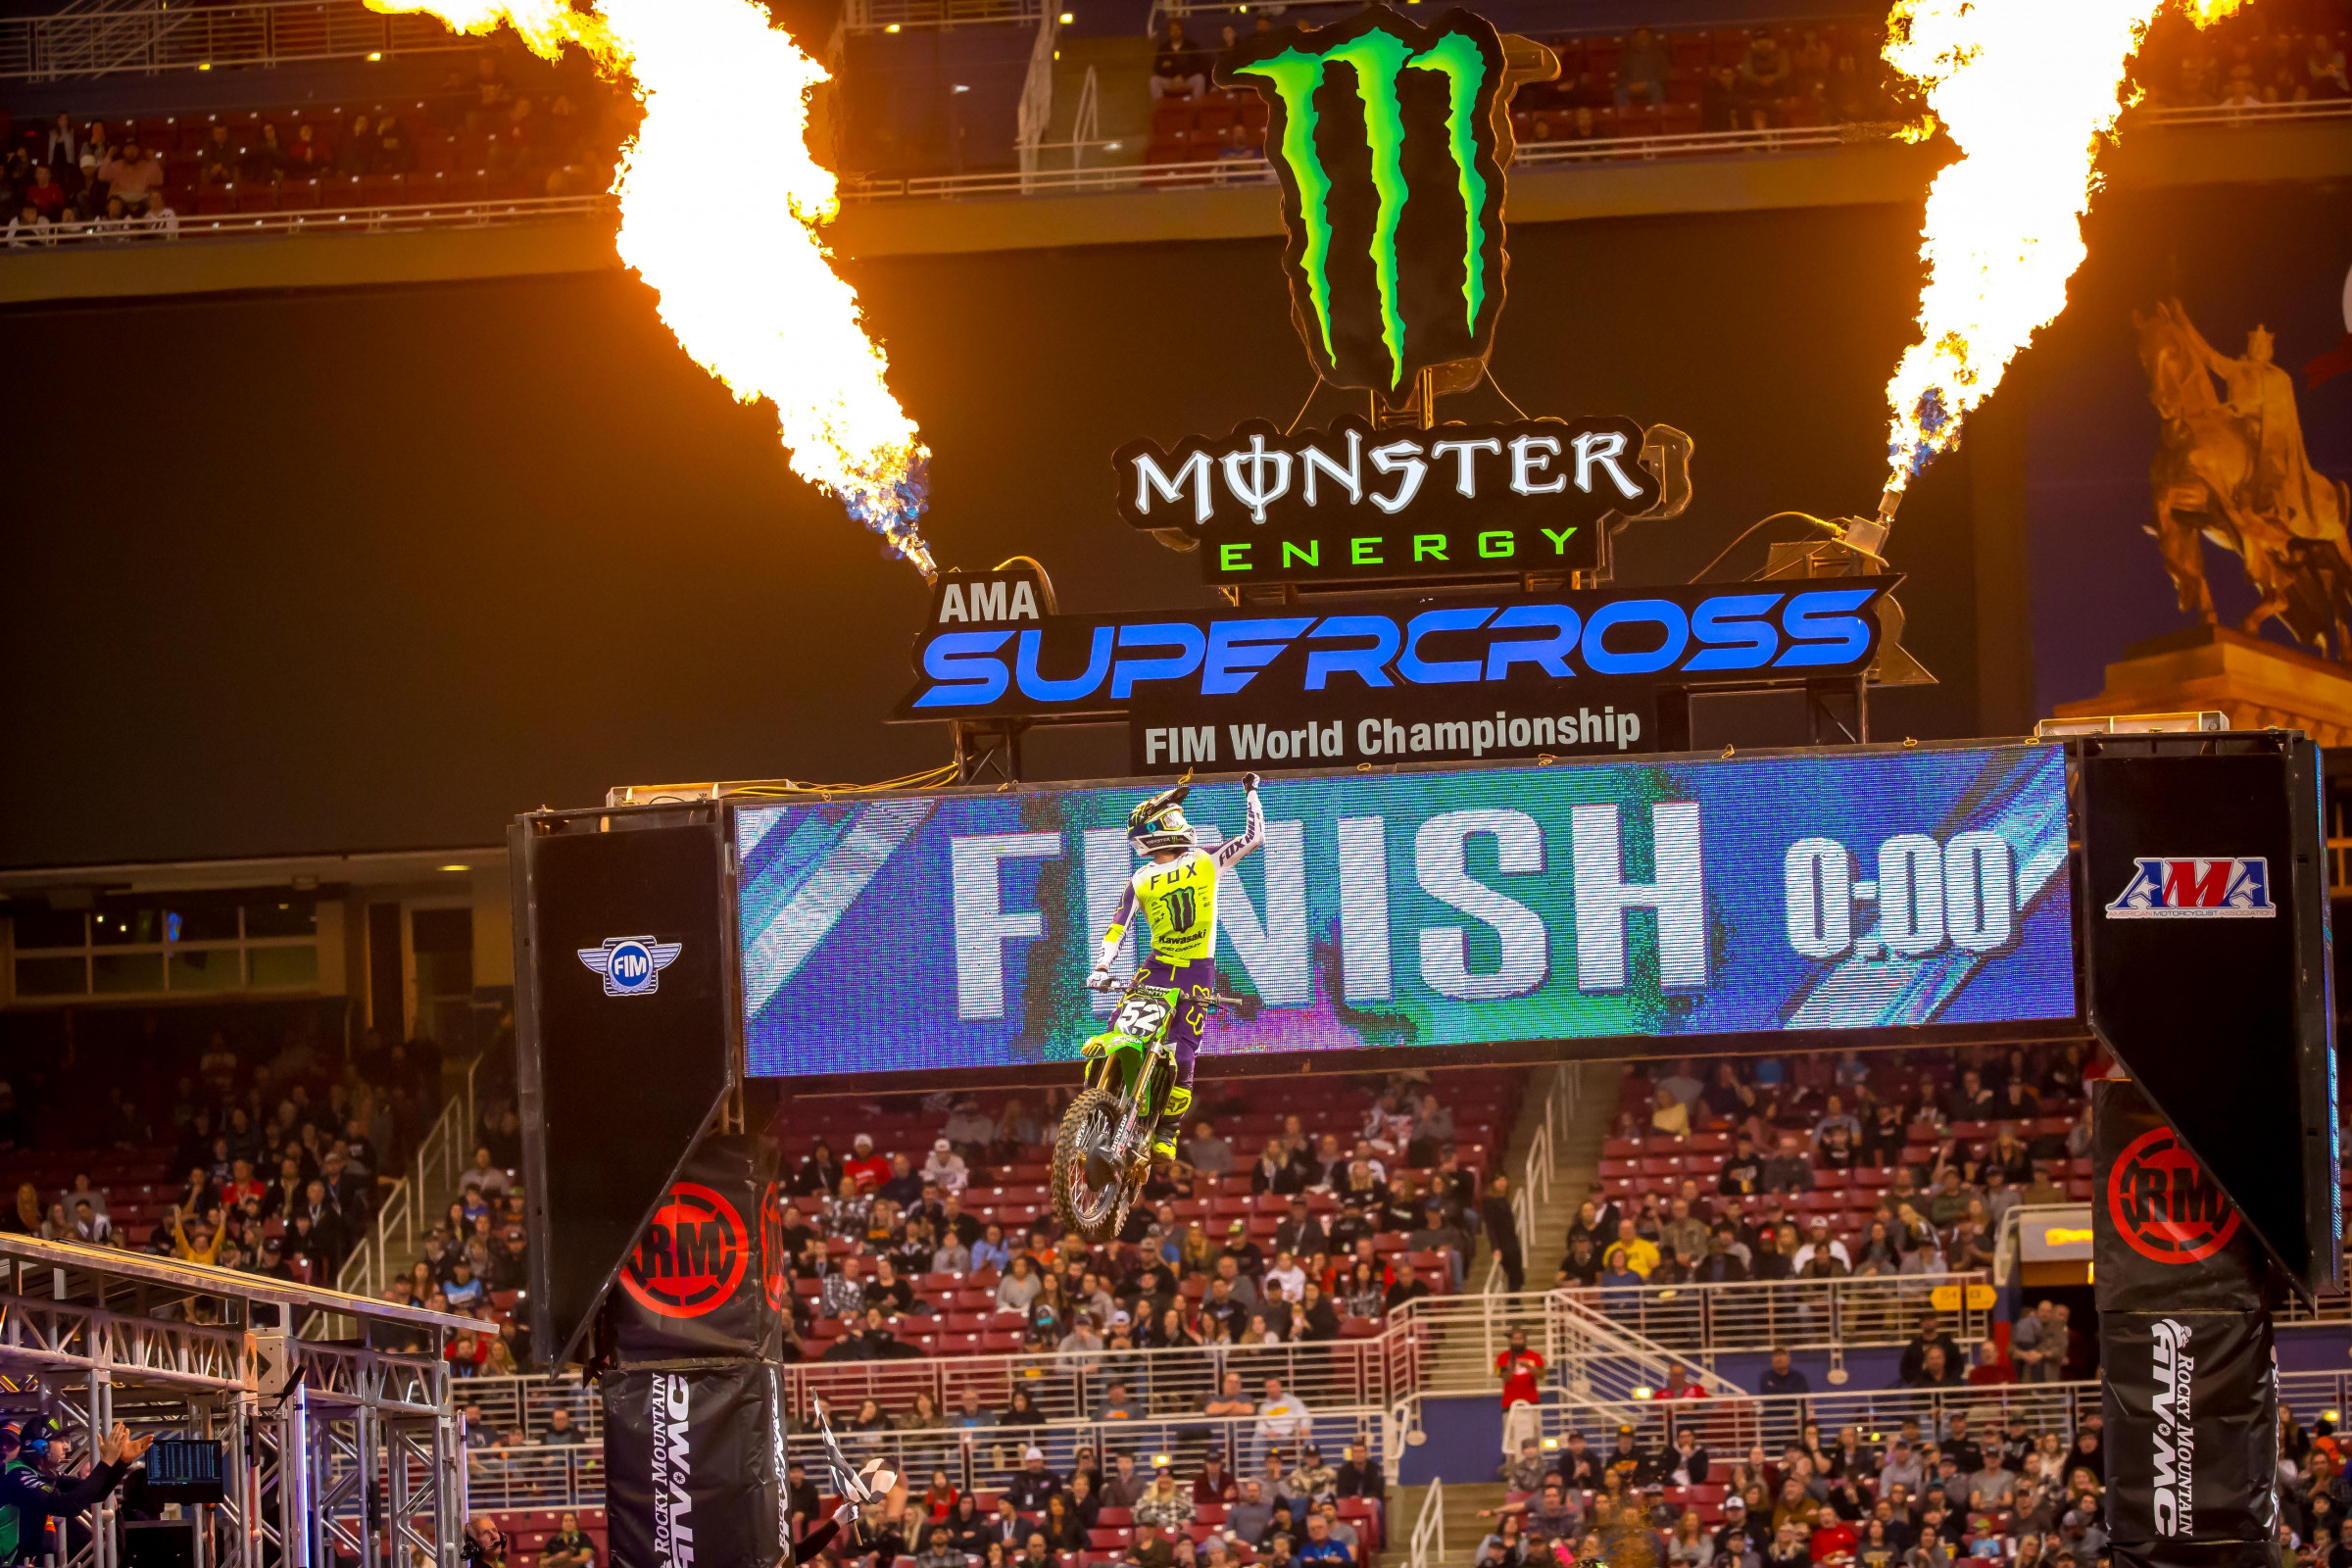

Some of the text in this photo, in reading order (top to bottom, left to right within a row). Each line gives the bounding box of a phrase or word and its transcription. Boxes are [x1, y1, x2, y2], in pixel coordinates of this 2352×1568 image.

[1133, 429, 1644, 524] MONSTER
[1220, 527, 1578, 571] ENERGY
[939, 581, 1040, 623] AMA
[911, 589, 1878, 708] SUPERCROSS
[1146, 706, 1641, 764] FIM World Championship
[1219, 838, 1246, 867] FOX
[1151, 861, 1197, 890] FOX
[2107, 859, 2275, 909] AMA
[953, 802, 1708, 1021] FINISH
[1158, 928, 1207, 945] Kawasaki
[613, 955, 647, 978] FIM
[1117, 1001, 1166, 1032] 52
[1110, 1113, 1128, 1152] DUNLOP
[642, 1372, 671, 1556] ROCKY MOUNTAIN
[2177, 1351, 2194, 1537] ROCKY MOUNTAIN
